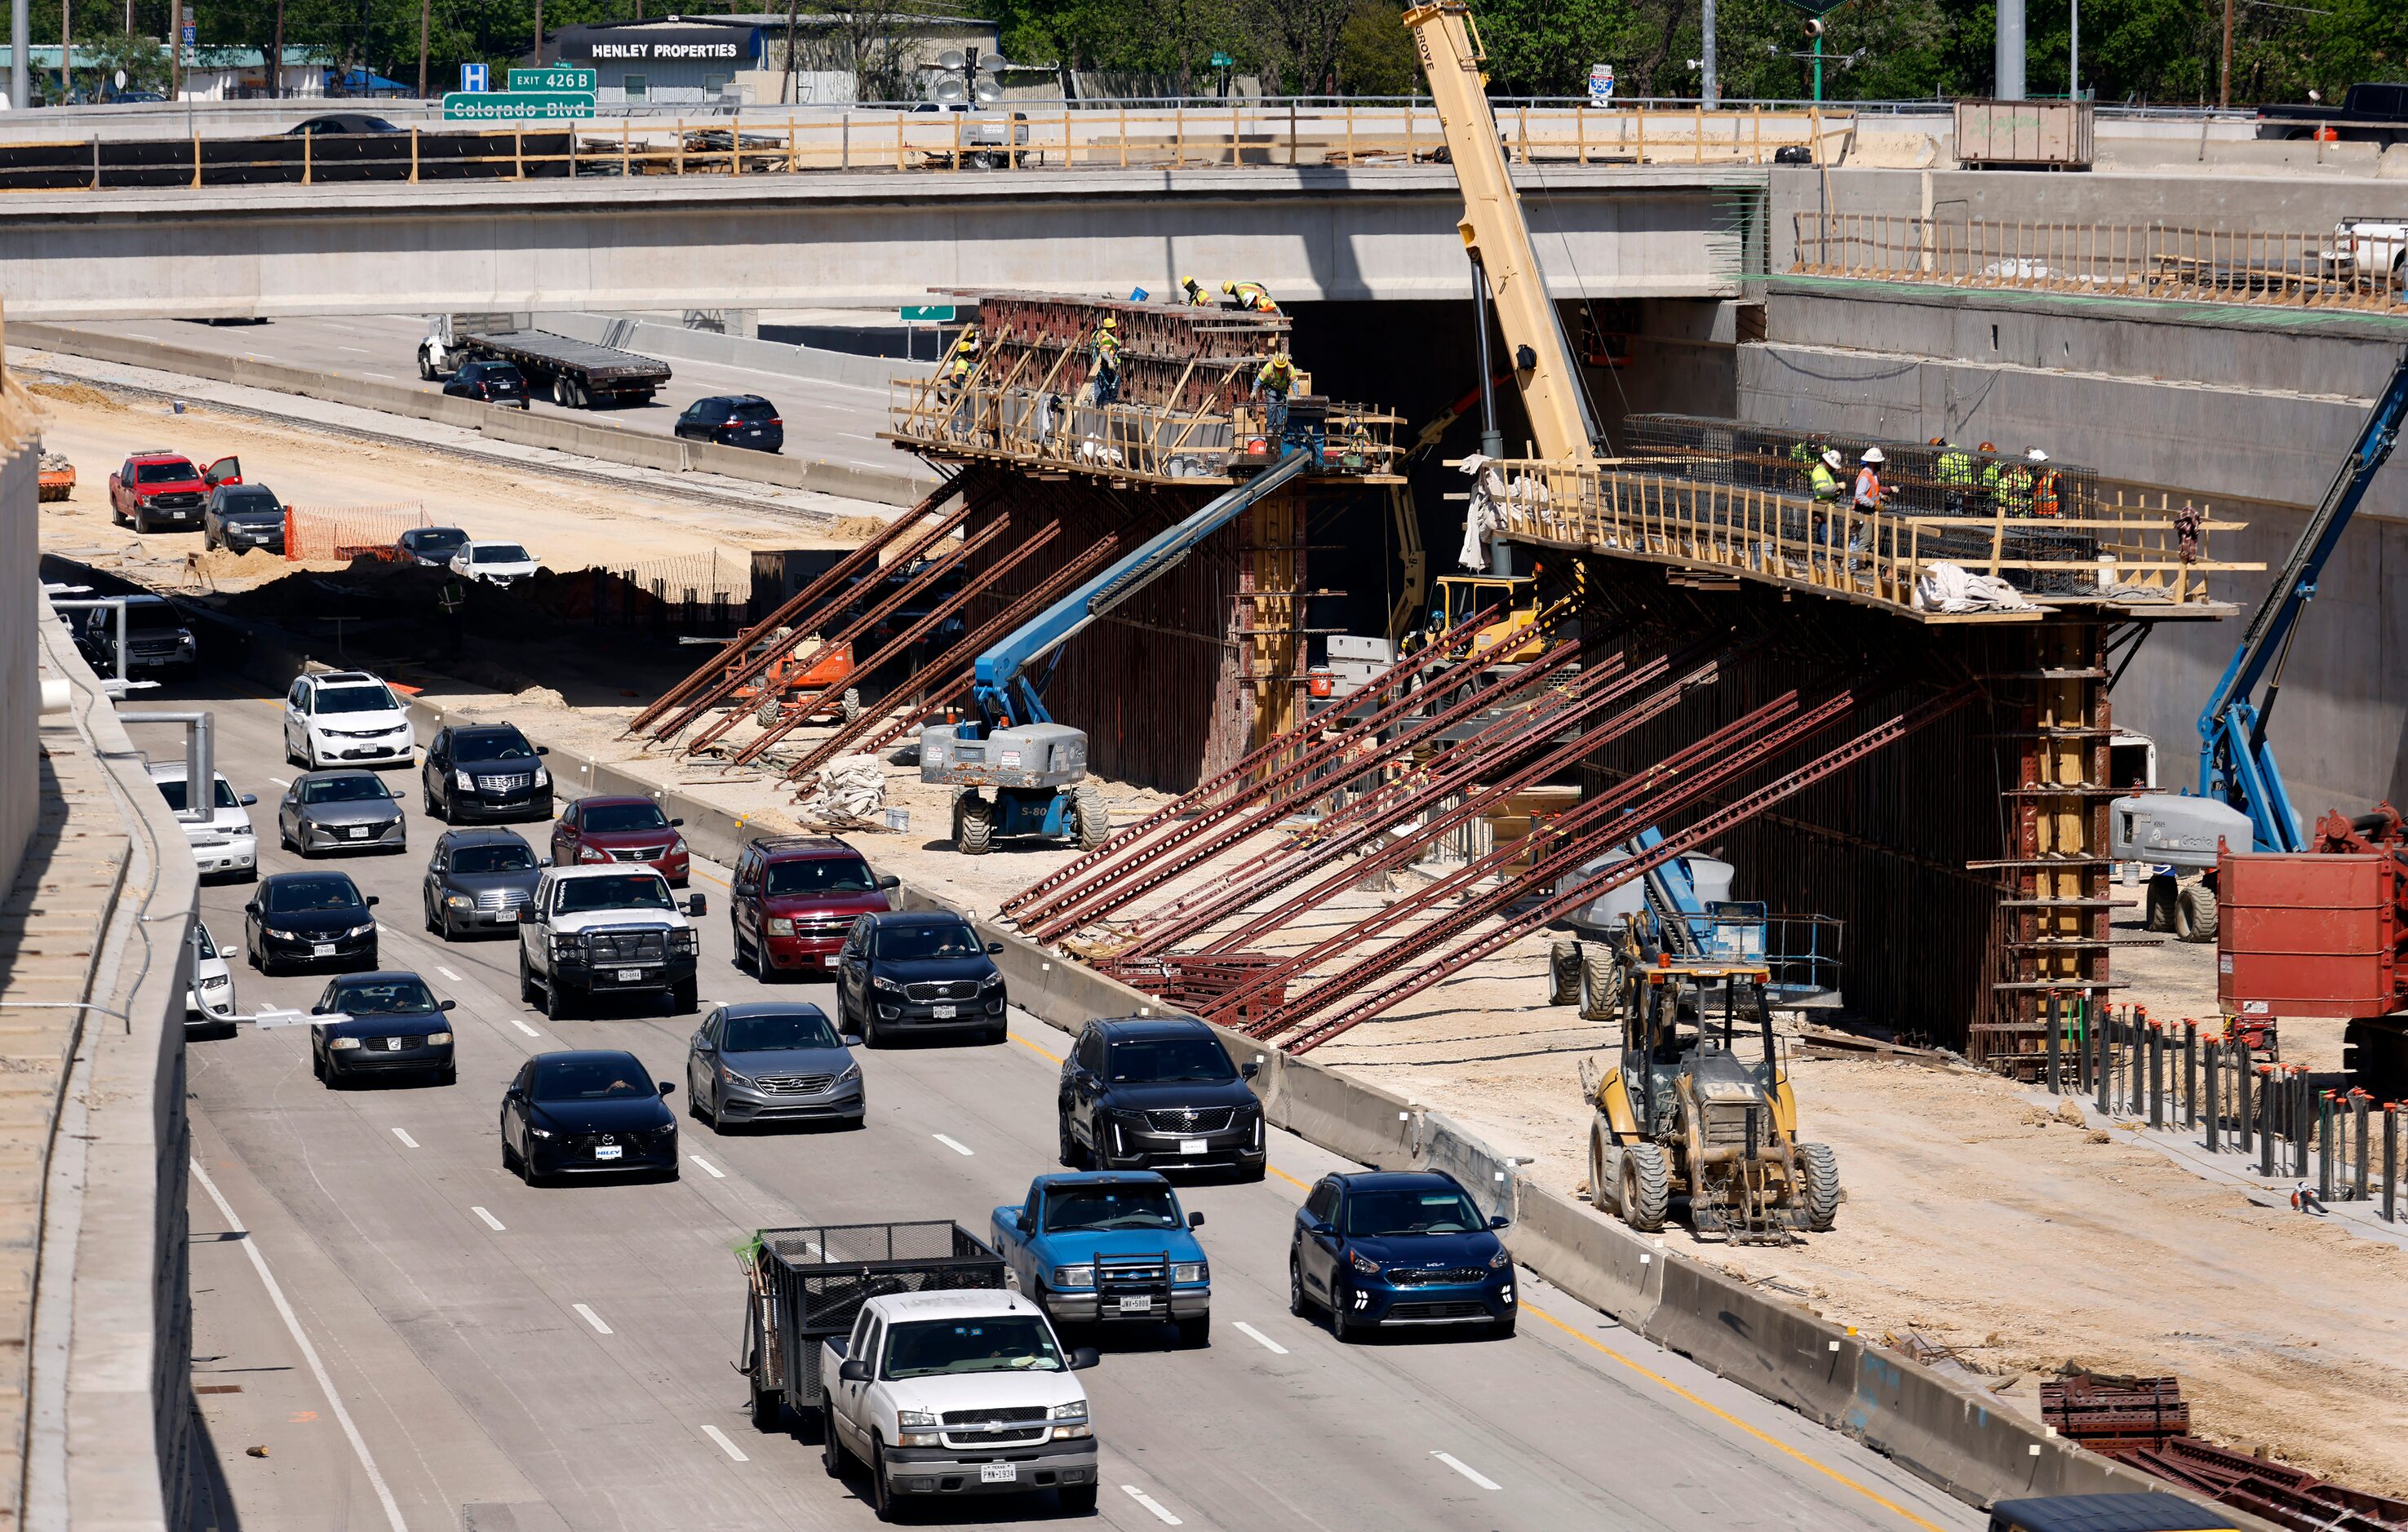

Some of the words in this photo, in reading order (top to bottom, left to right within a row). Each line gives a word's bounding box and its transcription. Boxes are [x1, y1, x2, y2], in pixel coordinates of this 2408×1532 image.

[592, 44, 649, 58] HENLEY
[654, 44, 737, 58] PROPERTIES
[1415, 25, 1435, 71] GROVE
[1594, 65, 1612, 73] NORTH
[465, 65, 485, 91] H
[517, 76, 539, 85] EXIT
[1592, 79, 1610, 91] 35E
[454, 102, 536, 118] Colorado
[547, 100, 586, 117] Blvd
[1021, 807, 1048, 817] S-80
[1704, 1082, 1755, 1100] CAT
